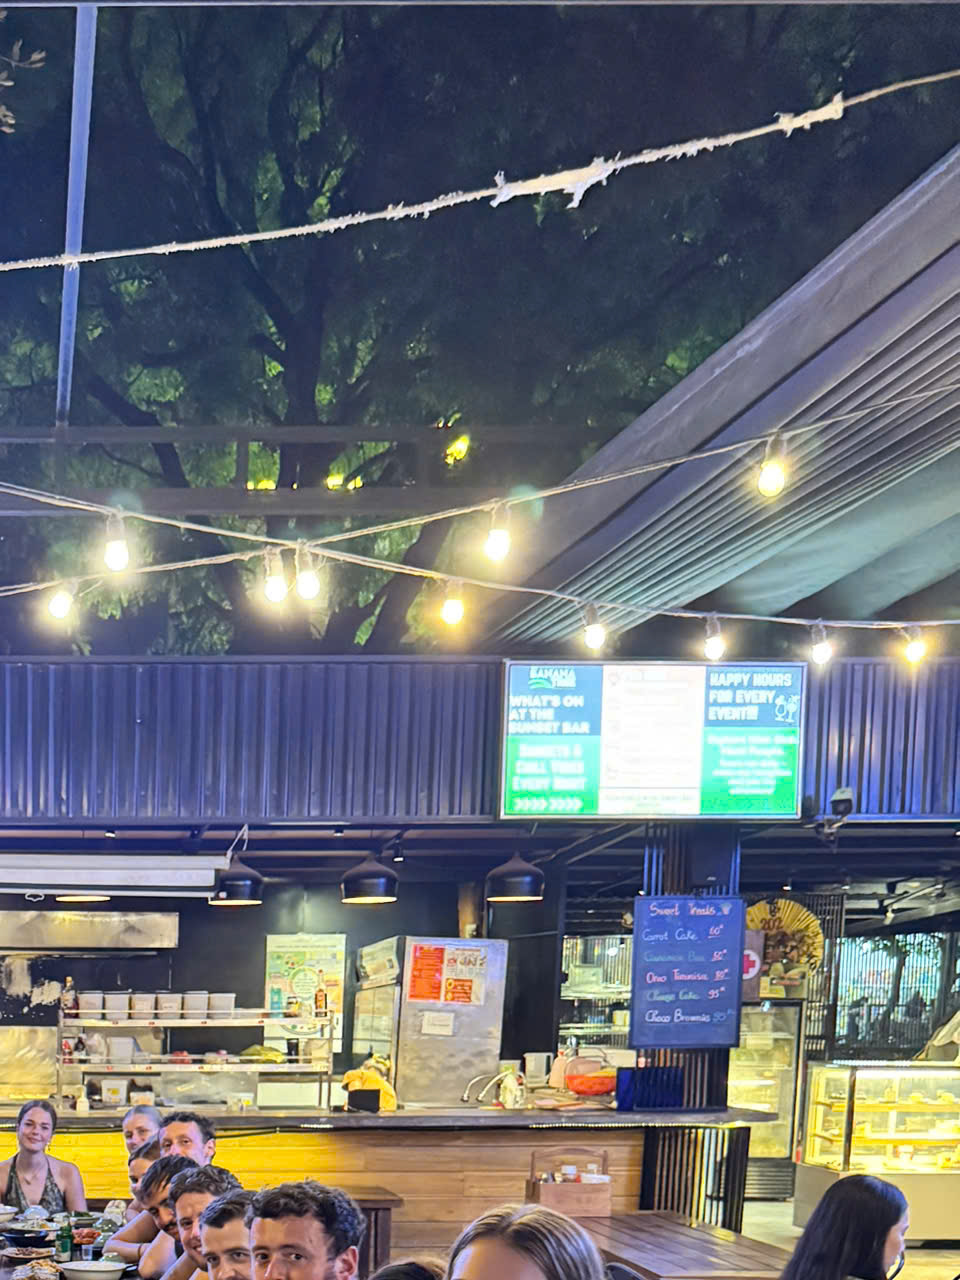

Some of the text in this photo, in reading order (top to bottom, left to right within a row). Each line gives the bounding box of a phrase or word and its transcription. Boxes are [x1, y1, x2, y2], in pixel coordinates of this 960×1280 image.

[710, 672, 793, 686] HAPPY HOURS
[509, 695, 585, 707] WHAT'S ON
[709, 689, 776, 704] FOR EVERY
[508, 708, 555, 720] AT THE
[561, 721, 590, 734] BAR
[642, 928, 668, 941] Carrot
[675, 928, 698, 941] Cake
[645, 1010, 671, 1023] Choco
